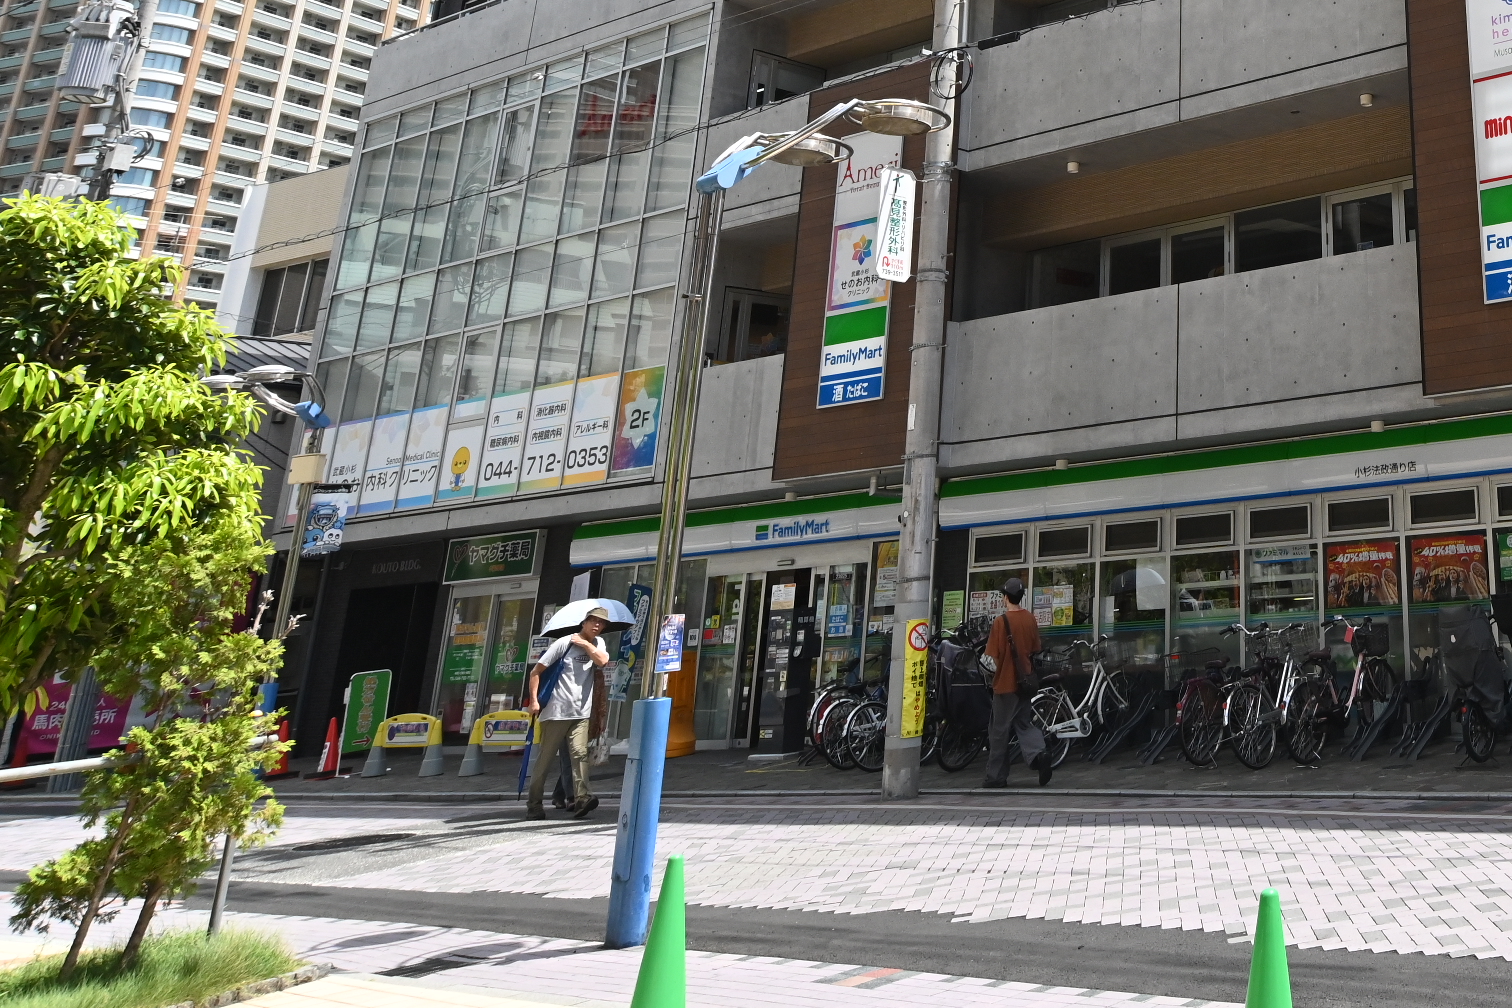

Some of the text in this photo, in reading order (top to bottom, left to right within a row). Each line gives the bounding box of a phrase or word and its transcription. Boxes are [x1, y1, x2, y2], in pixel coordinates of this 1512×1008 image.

[840, 274, 879, 290] せのお内科
[847, 287, 871, 298] クリニック
[824, 344, 883, 367] FamilyMart
[832, 382, 869, 402] 酒 たばこ
[574, 419, 609, 435] アレルギー科
[629, 408, 650, 430] 2F
[405, 452, 424, 462] Medical
[425, 450, 440, 460] Clinic
[1354, 461, 1417, 478] 小杉法政通り店
[772, 519, 830, 539] FamilyMart
[469, 540, 531, 565] ヤマグチ薬局
[372, 562, 399, 574] KOUTO
